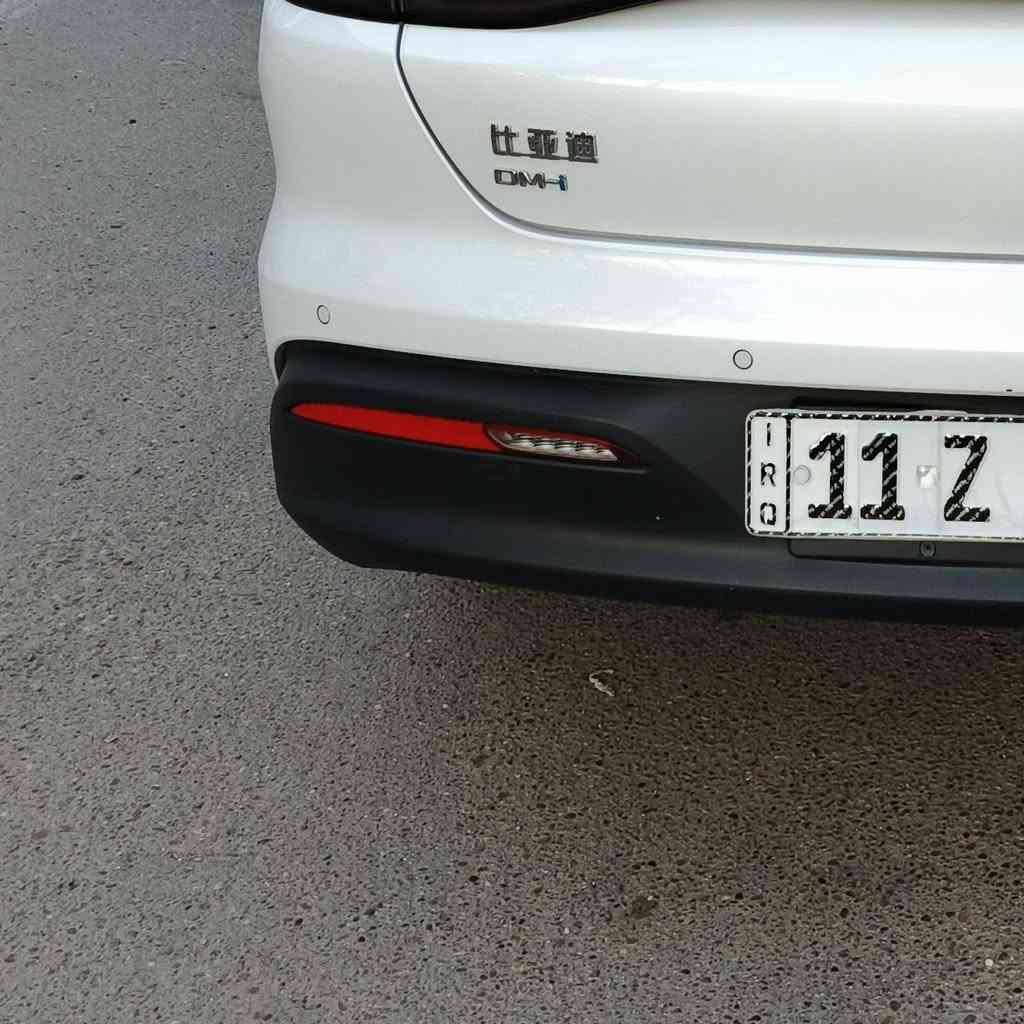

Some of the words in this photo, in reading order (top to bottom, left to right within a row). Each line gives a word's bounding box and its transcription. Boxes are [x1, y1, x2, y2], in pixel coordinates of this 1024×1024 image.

[490, 123, 599, 164] 比亚迪
[807, 432, 906, 522] 11
[943, 433, 991, 524] Z
